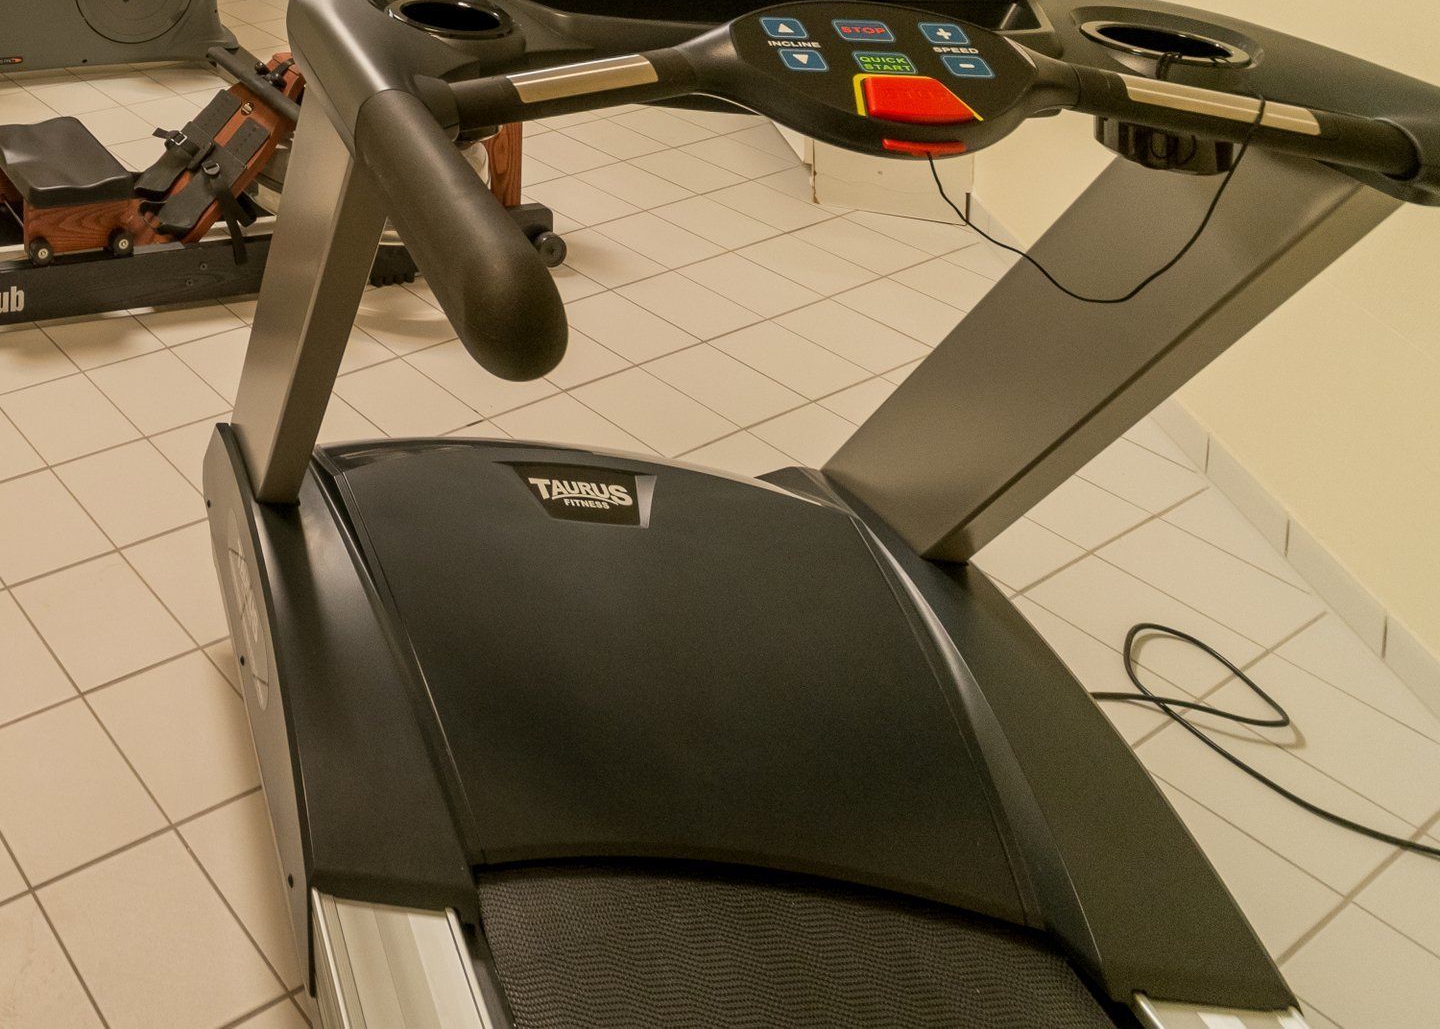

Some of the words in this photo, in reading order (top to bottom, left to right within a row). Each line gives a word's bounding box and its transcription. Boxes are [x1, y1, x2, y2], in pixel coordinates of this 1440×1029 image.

[840, 26, 886, 35] STOP
[768, 40, 822, 49] INCLINE
[932, 46, 979, 55] SPEED
[859, 56, 907, 65] QUICK
[863, 63, 911, 72] START
[528, 477, 634, 506] TAURUS
[563, 498, 610, 510] FITNESS
